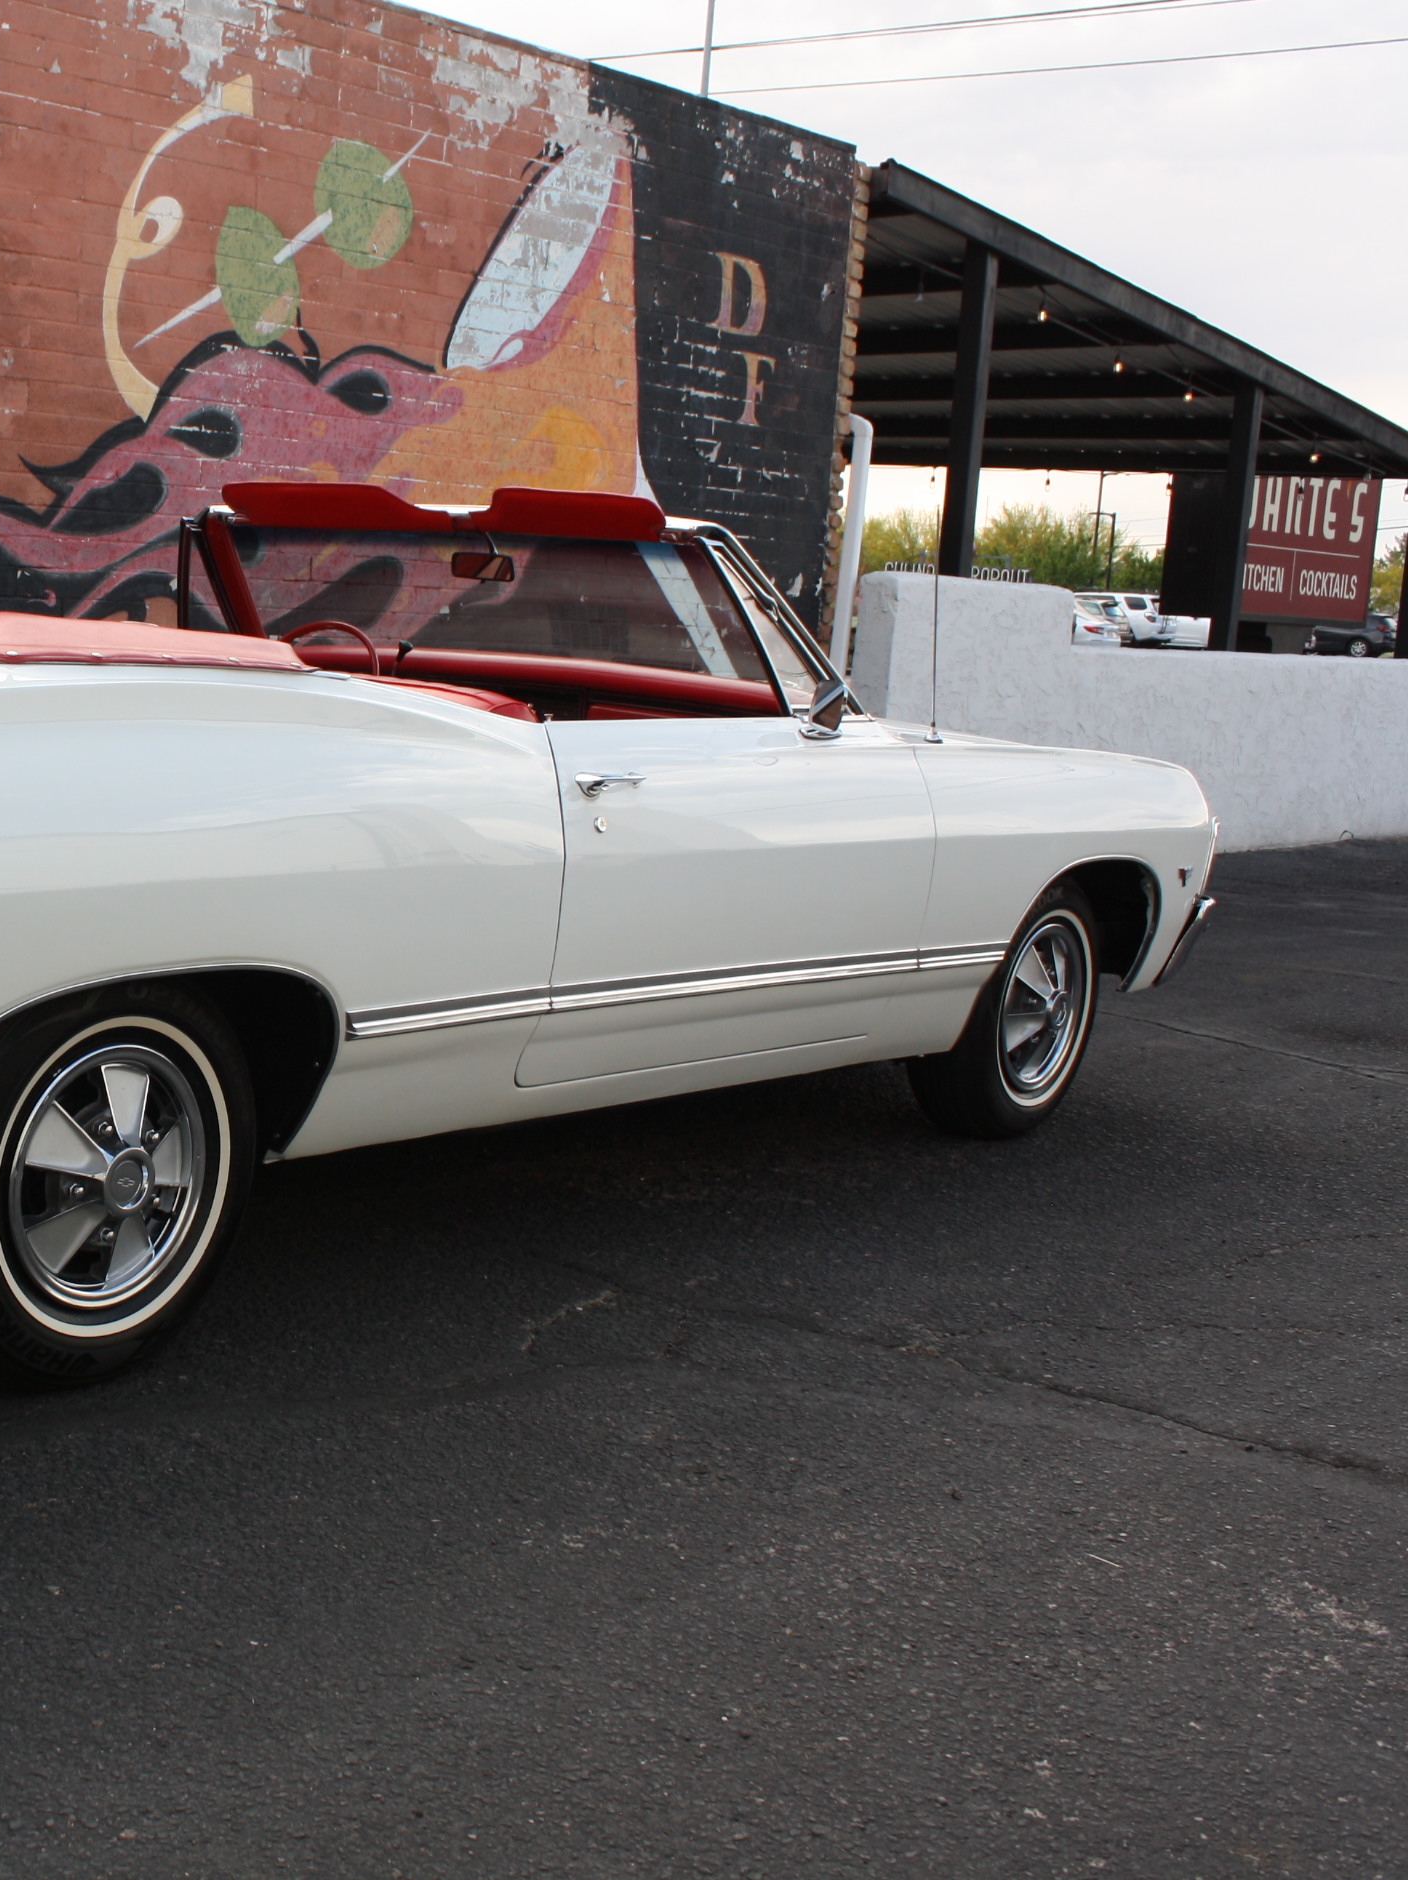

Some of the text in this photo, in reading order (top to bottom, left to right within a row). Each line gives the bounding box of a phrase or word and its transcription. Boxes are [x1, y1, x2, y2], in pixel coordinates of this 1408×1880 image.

[704, 252, 767, 337] D
[732, 351, 776, 426] F
[1242, 563, 1358, 601] ITCHEN COCKTAILS
